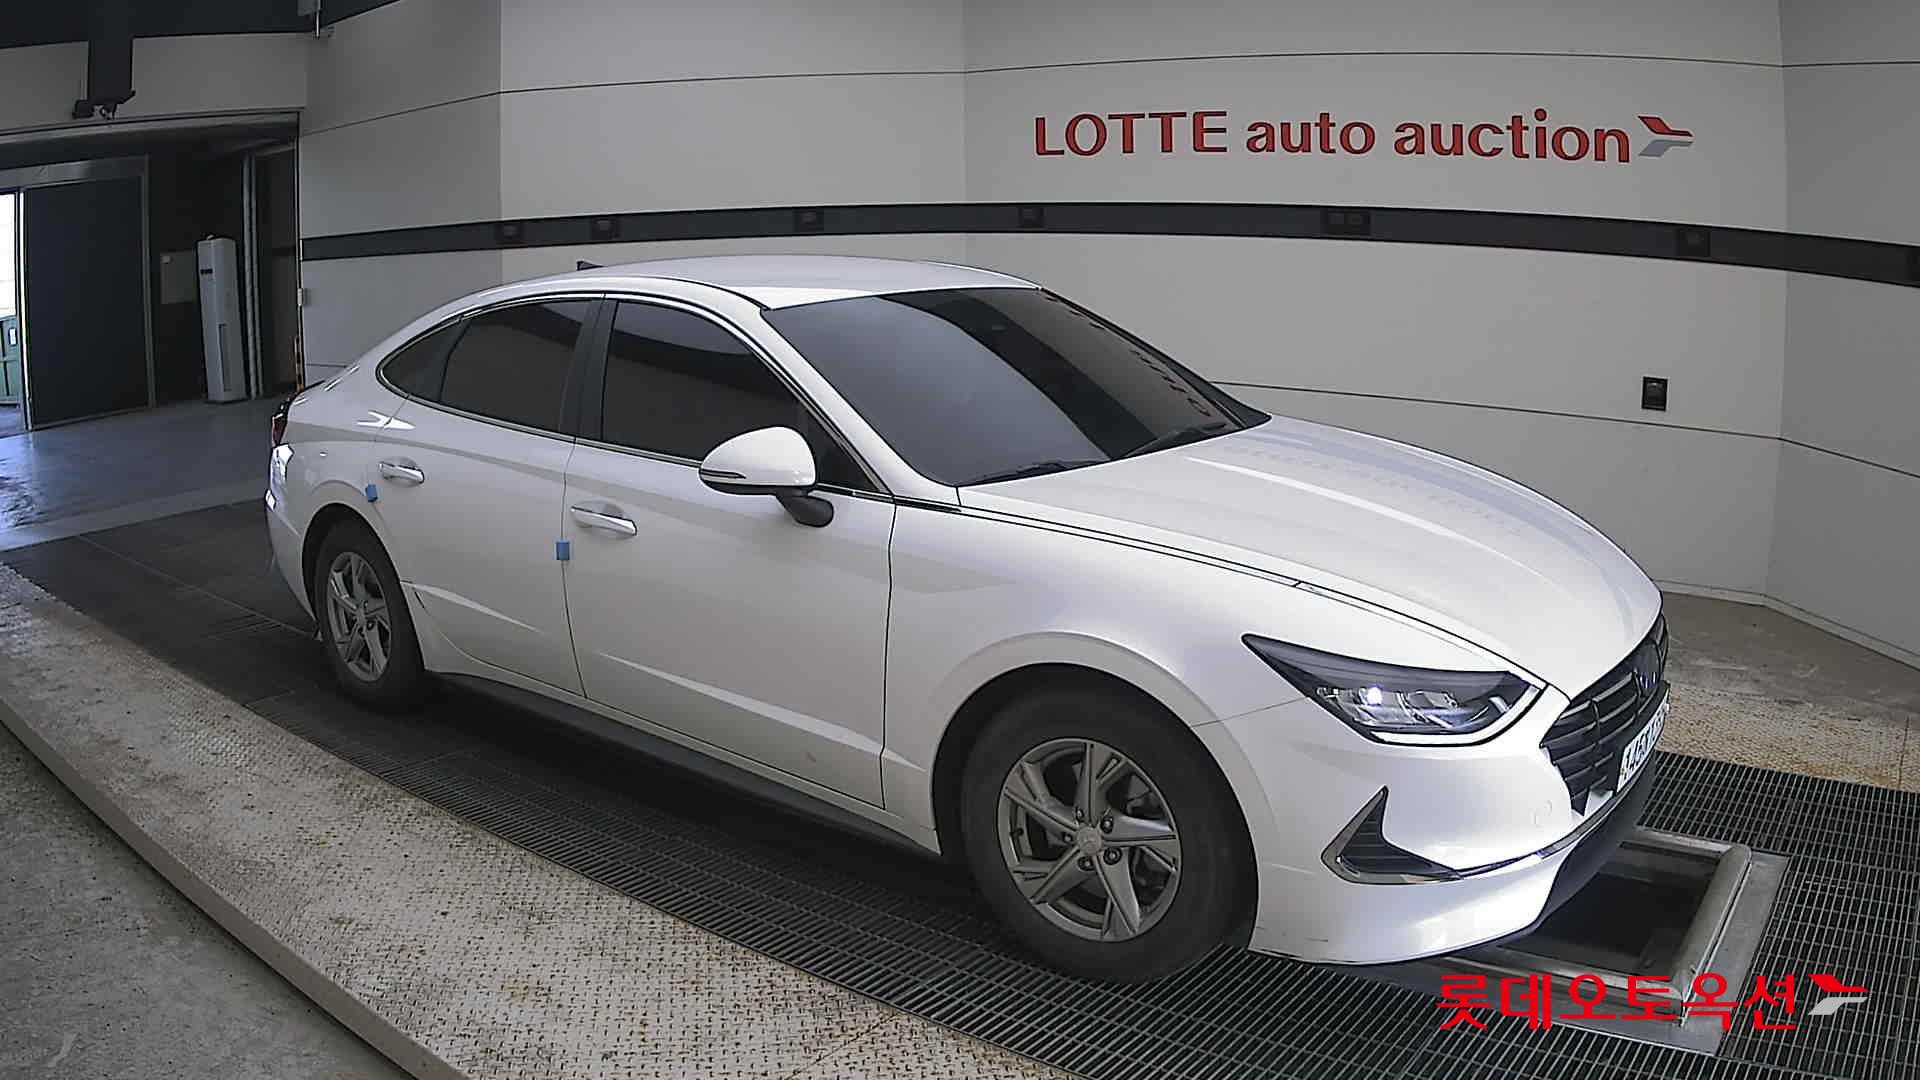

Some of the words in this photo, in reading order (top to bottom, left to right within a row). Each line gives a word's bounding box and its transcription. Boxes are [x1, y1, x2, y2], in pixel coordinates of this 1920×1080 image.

[1034, 110, 1228, 157] LOTTE
[1246, 112, 1376, 155] auto
[1393, 108, 1631, 163] auction
